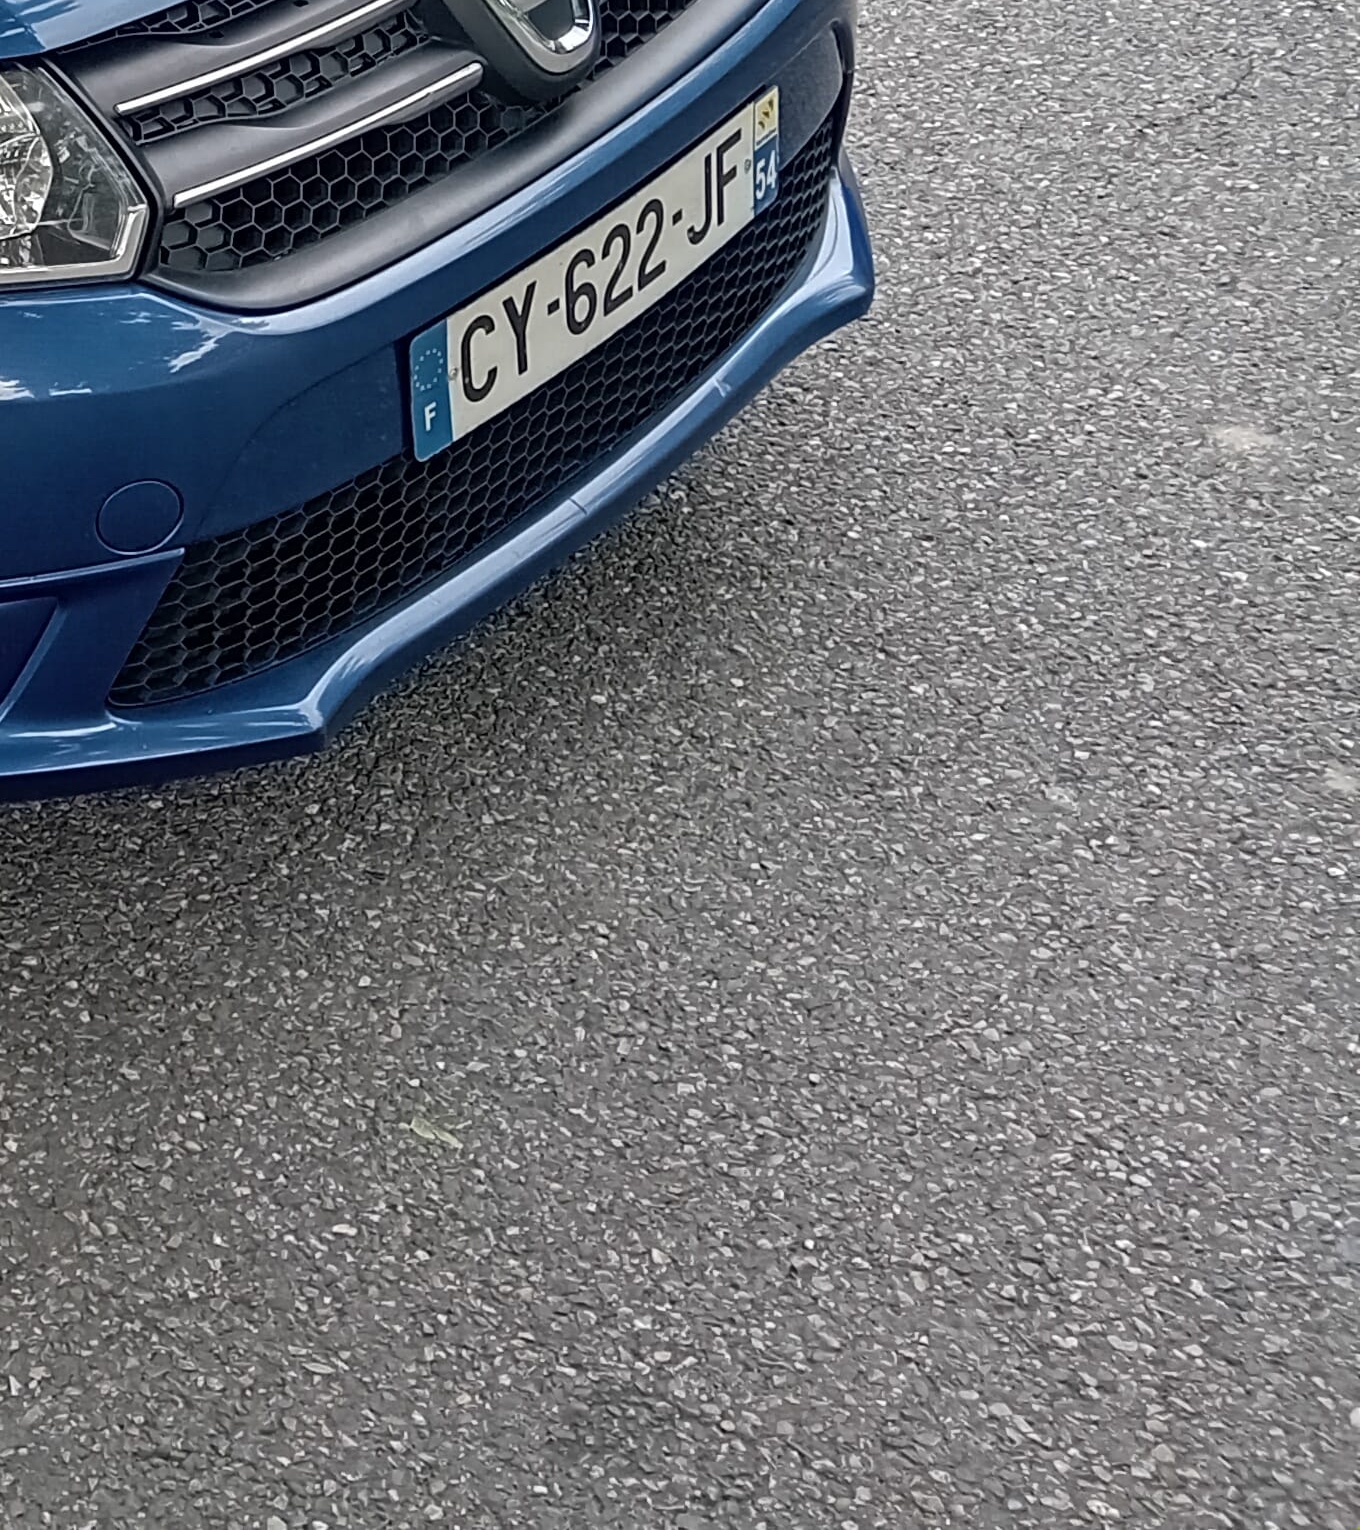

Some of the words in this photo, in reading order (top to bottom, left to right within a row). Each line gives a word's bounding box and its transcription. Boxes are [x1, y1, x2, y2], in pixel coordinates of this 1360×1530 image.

[755, 150, 777, 200] 54
[459, 128, 743, 403] CY-622-JF
[424, 402, 437, 431] F
